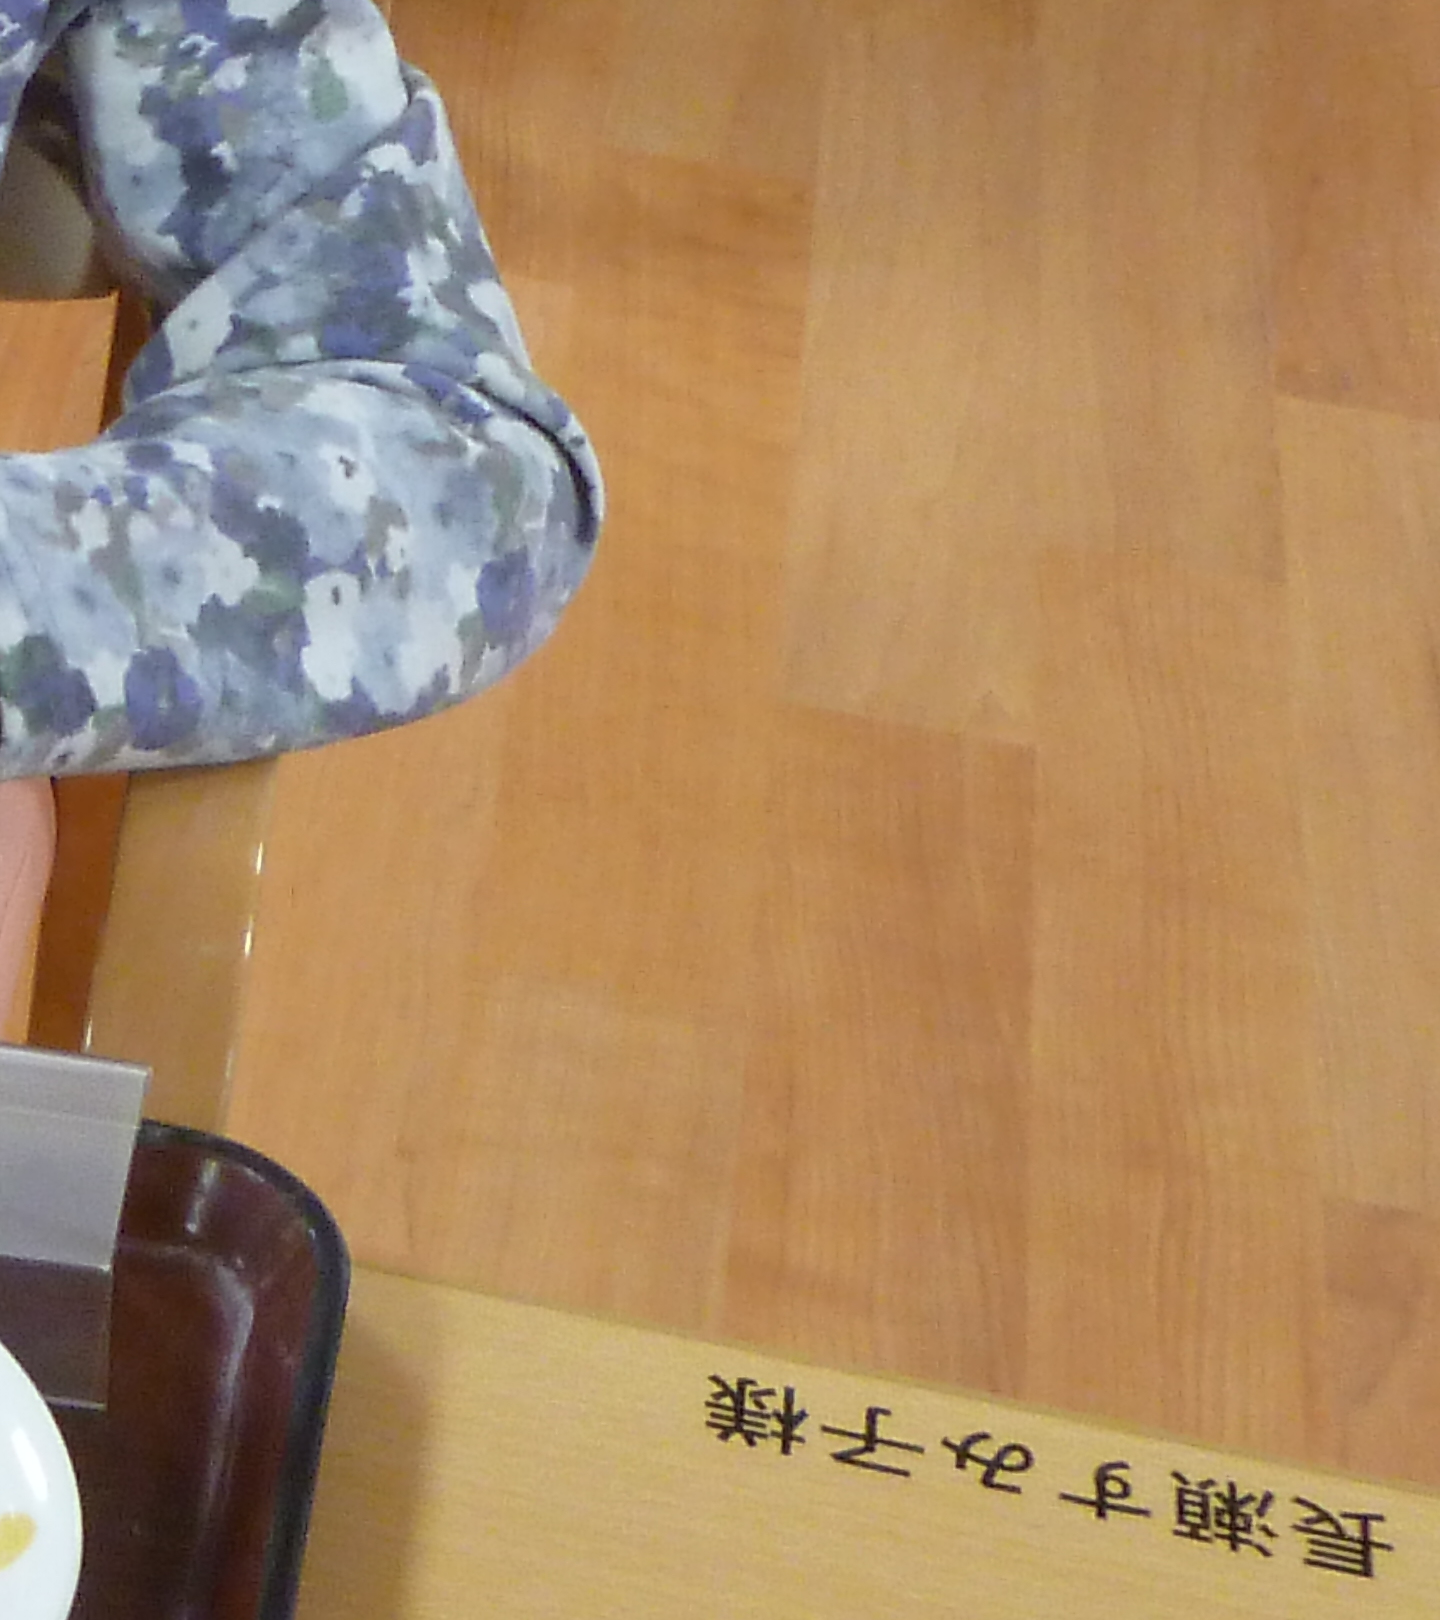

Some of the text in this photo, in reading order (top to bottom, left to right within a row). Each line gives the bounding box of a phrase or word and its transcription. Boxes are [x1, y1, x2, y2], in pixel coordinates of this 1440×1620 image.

[704, 1373, 1393, 1578] 長瀬すみ子様
